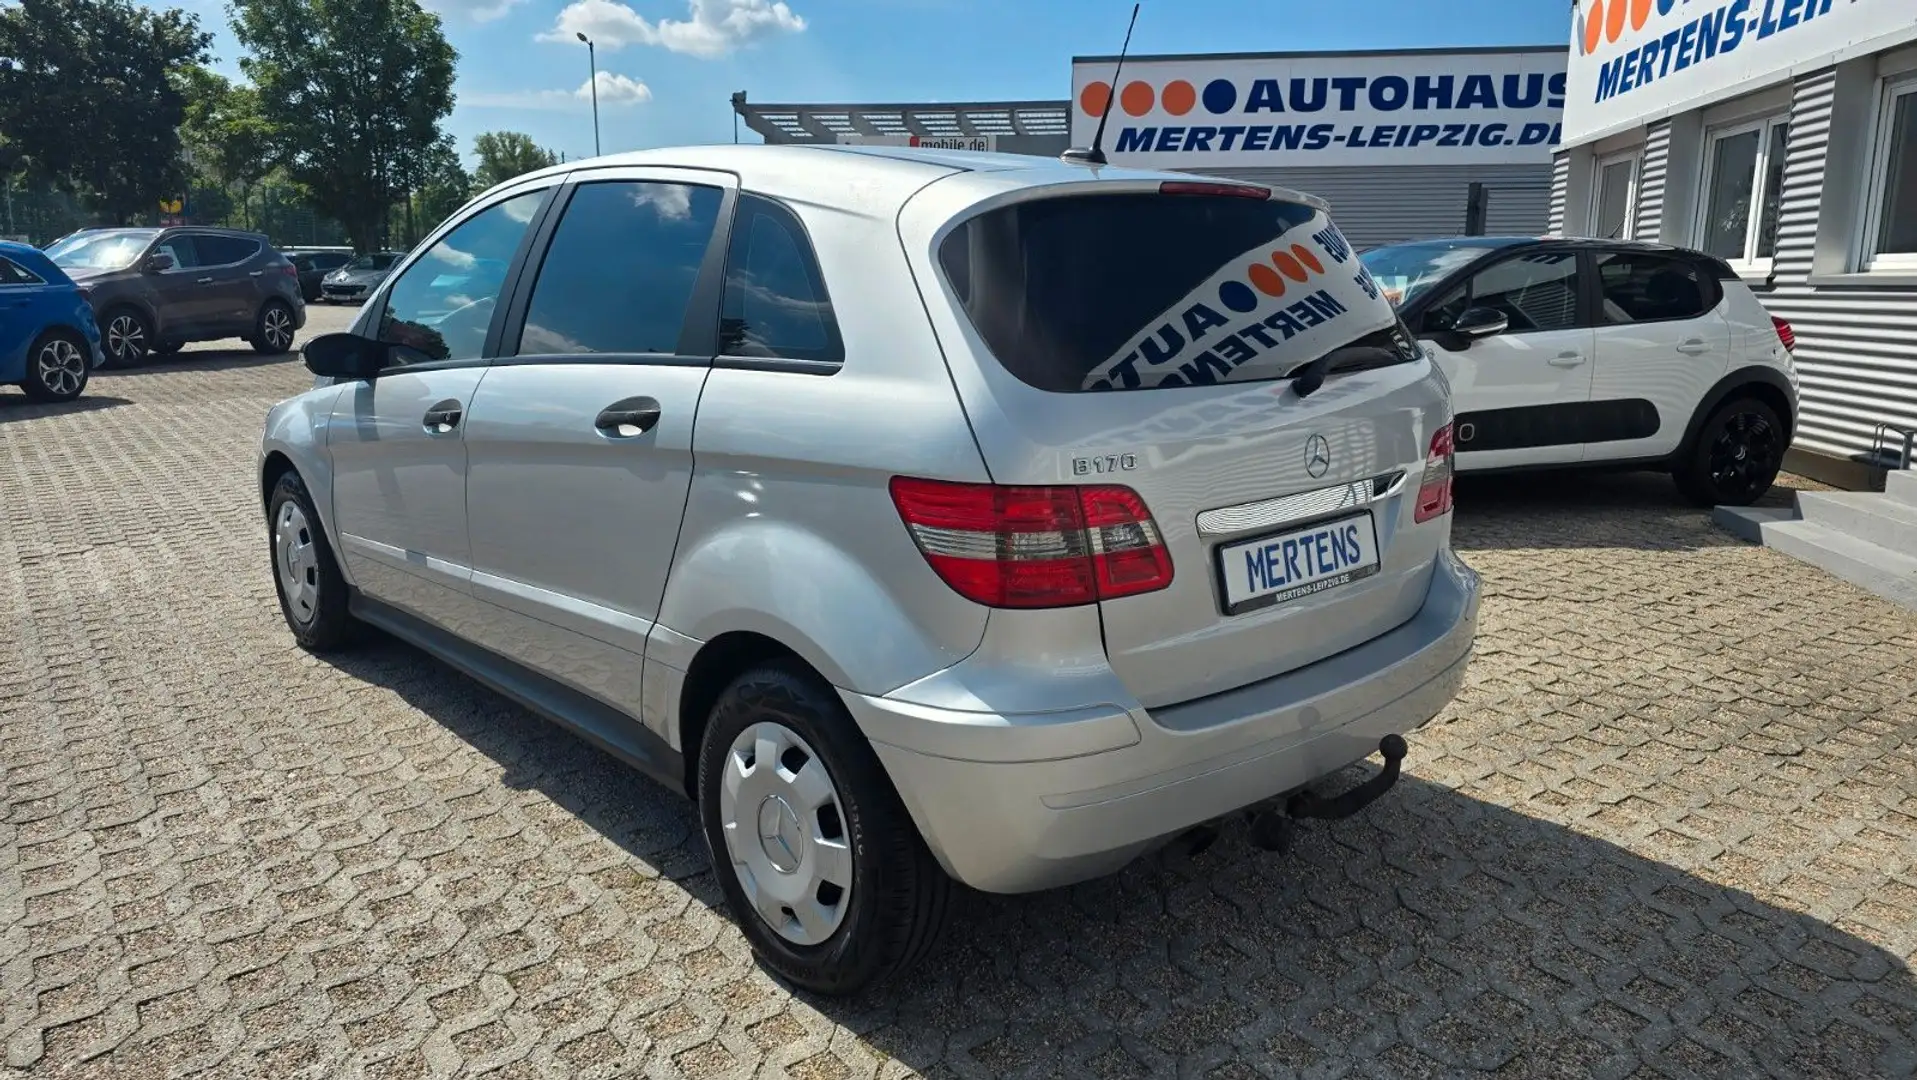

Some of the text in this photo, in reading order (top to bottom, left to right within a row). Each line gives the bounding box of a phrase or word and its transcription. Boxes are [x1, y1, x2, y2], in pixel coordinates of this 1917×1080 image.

[921, 138, 985, 151] mobilede
[1245, 524, 1360, 592] MERTENS
[1276, 574, 1350, 601] MERTENS-LEIPZIG.DE
